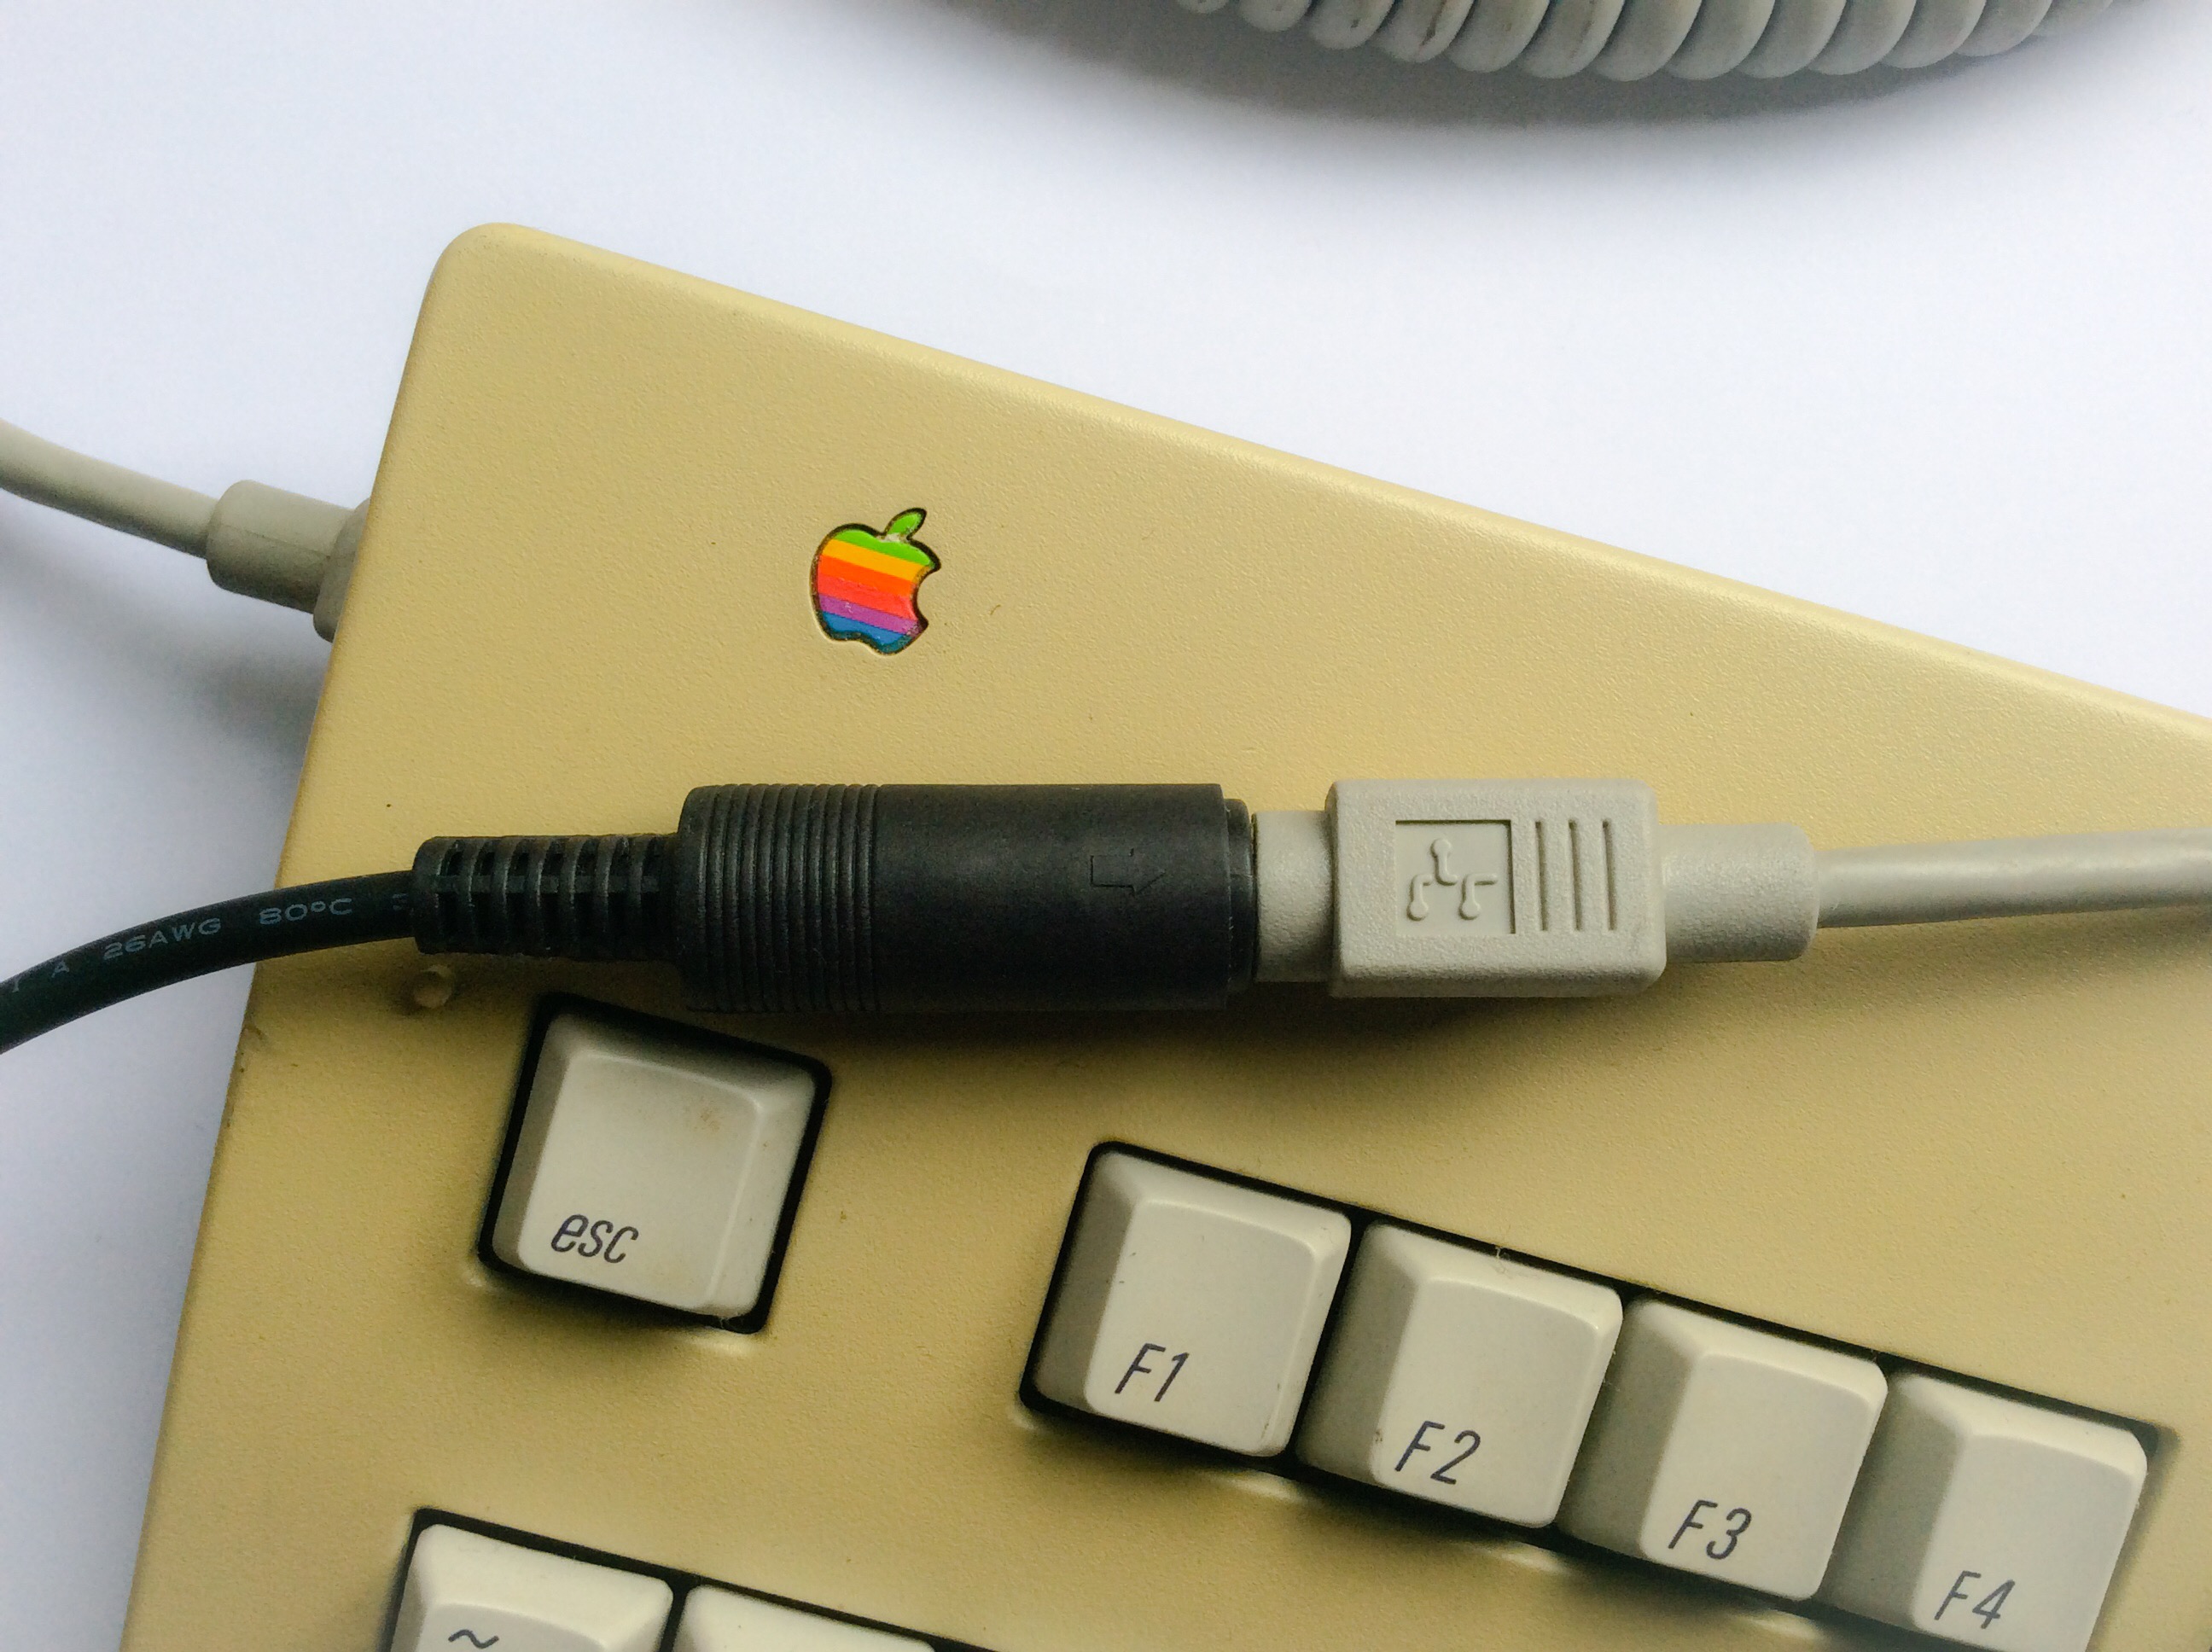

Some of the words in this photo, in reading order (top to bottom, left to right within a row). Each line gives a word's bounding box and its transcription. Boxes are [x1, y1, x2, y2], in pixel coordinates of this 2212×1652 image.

[102, 917, 222, 960] 26AWG
[551, 1214, 638, 1263] esc
[1114, 1342, 1190, 1403] F1
[1394, 1420, 1481, 1486] F2
[1667, 1499, 1753, 1561] F3
[1934, 1570, 2017, 1630] F4
